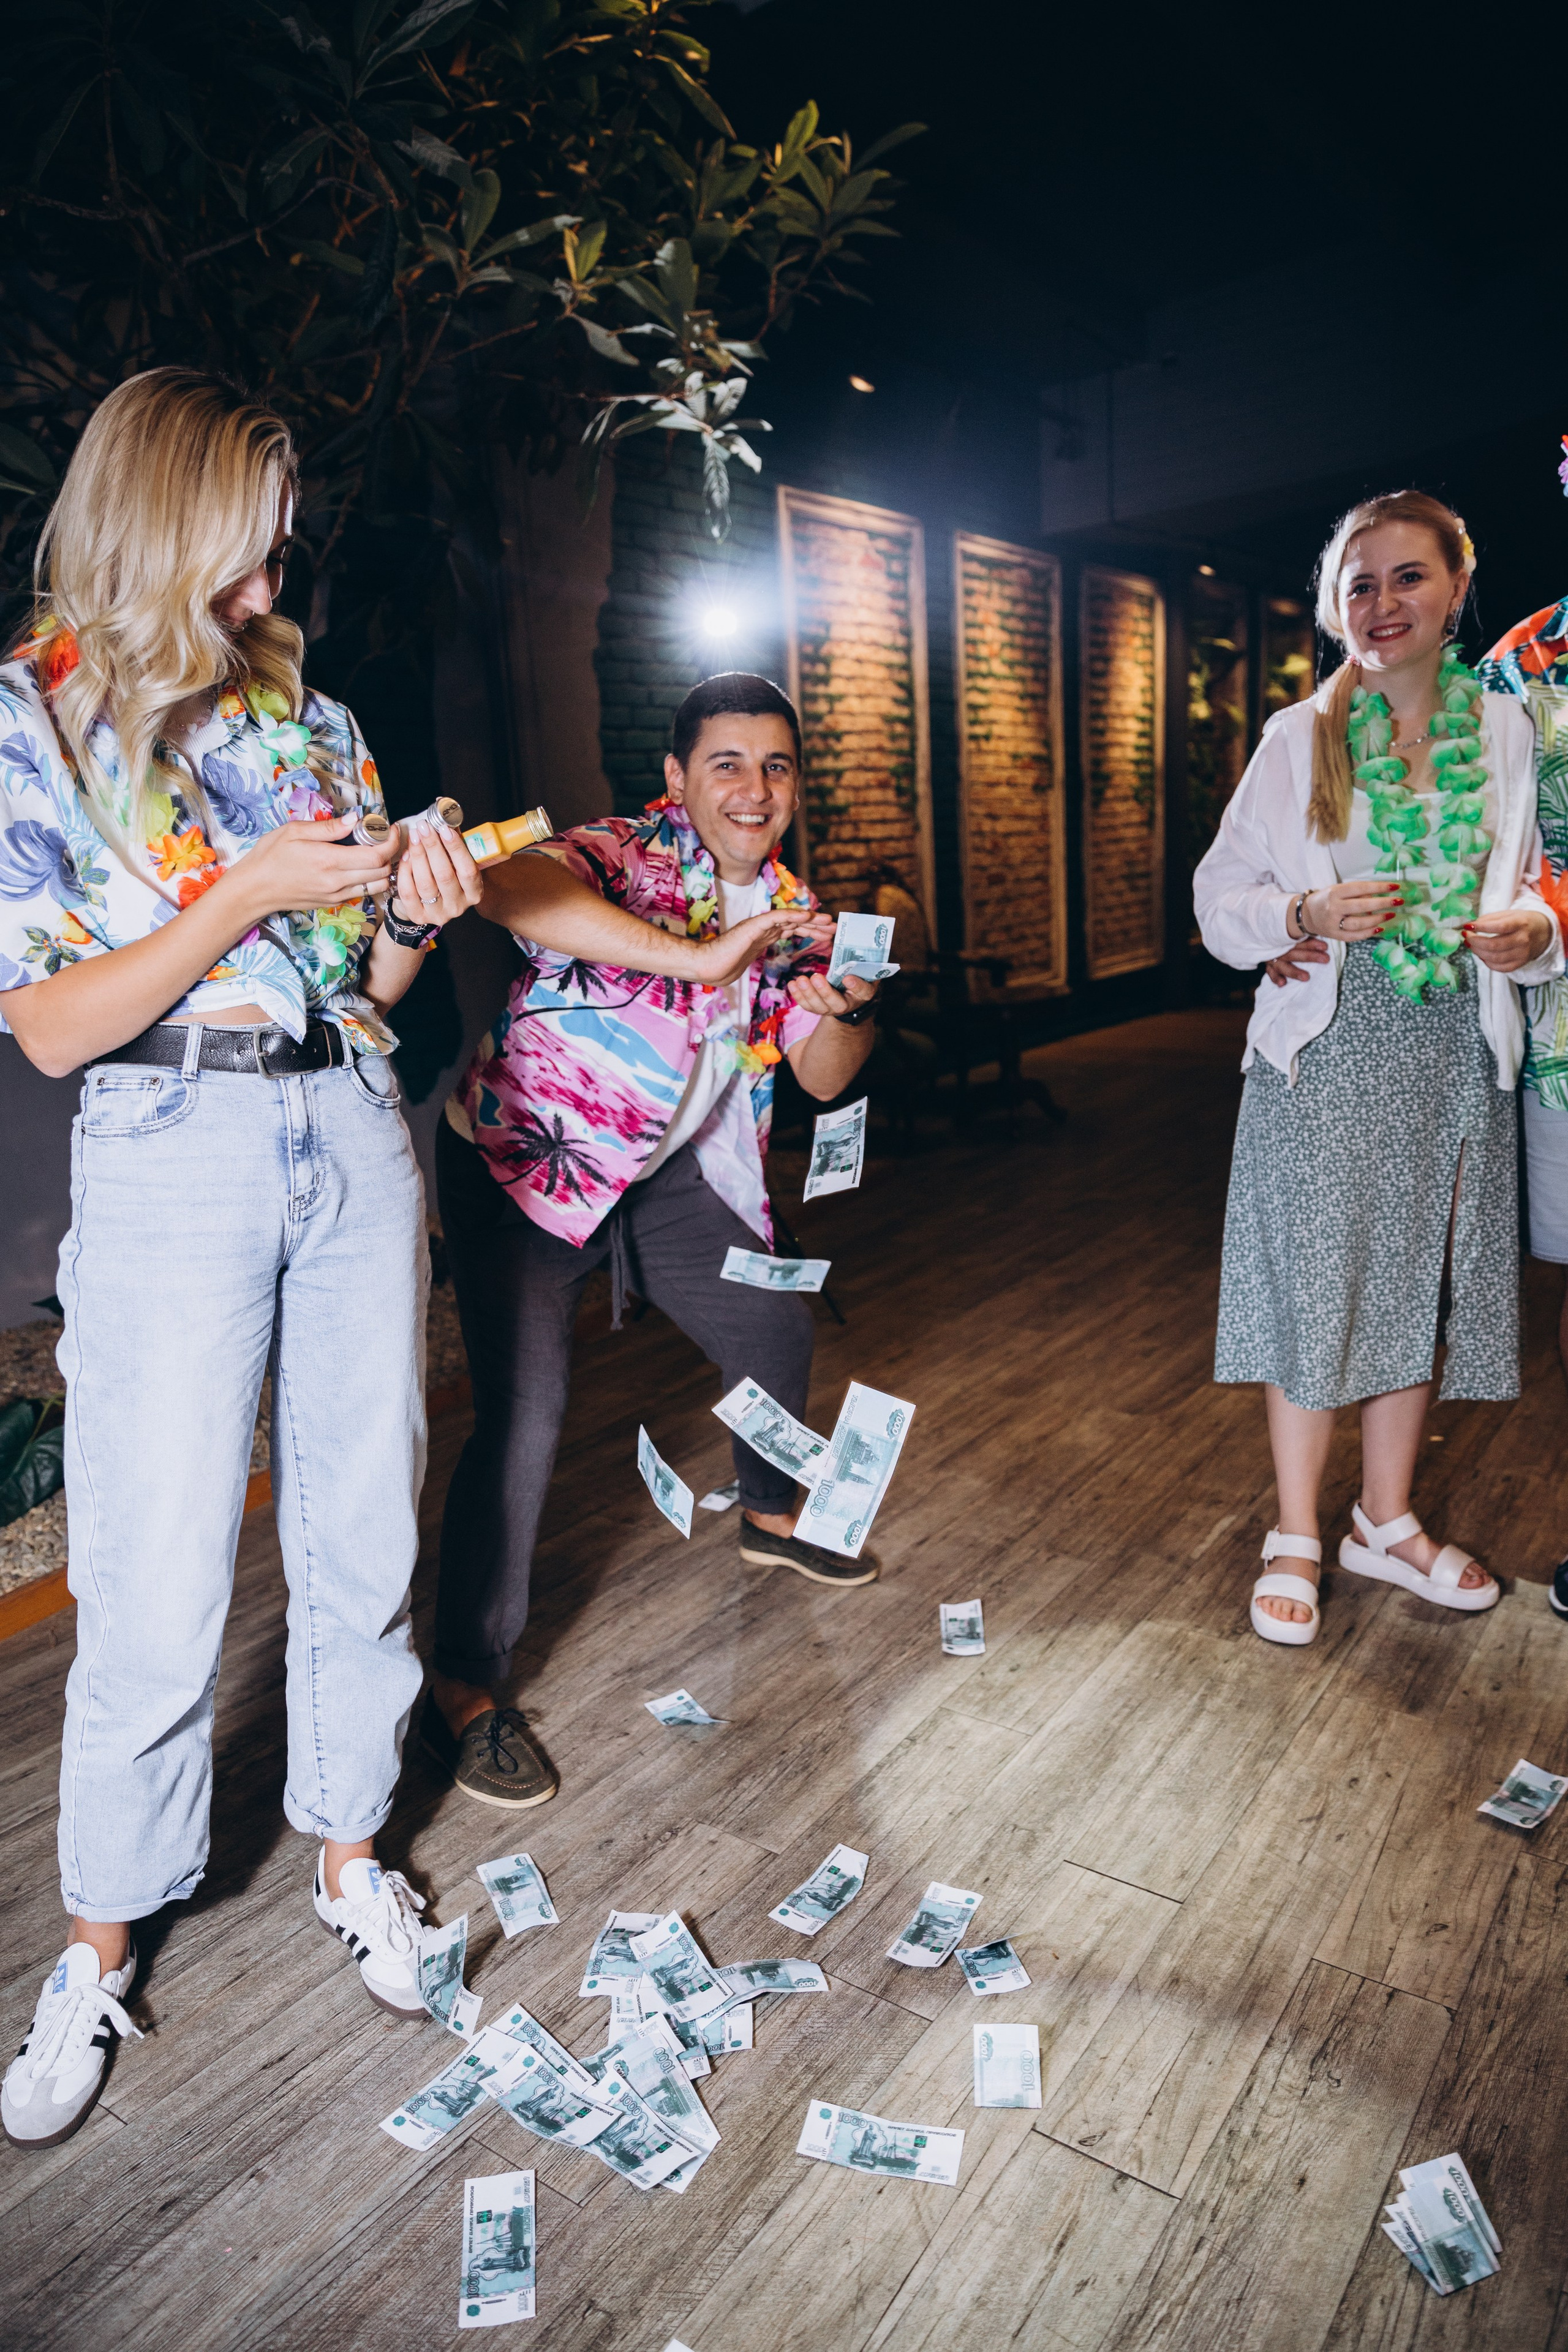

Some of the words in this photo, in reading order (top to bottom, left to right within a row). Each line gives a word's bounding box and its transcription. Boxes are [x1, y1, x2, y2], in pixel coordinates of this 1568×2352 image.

[443, 803, 458, 816] AMG
[760, 1398, 783, 1419] 1000
[845, 1395, 858, 1425] ТЫСЯЧА
[892, 1412, 903, 1436] 1000
[810, 1479, 835, 1518] 1000
[850, 1525, 862, 1546] 1000
[499, 1898, 516, 1920] 1000
[542, 1904, 551, 1917] 1000
[787, 1893, 805, 1907] 1000
[956, 1908, 971, 1924] 1000
[677, 1934, 694, 1956] 1000
[591, 1954, 605, 1975] 1000
[717, 1967, 736, 1978] 100
[965, 1960, 981, 1978] 1000
[429, 2000, 448, 2022] 1000
[521, 2021, 540, 2041] 1000
[440, 2069, 453, 2081] БИЛЕТ
[453, 2056, 467, 2069] БАНКА
[466, 2033, 487, 2055] ПРИКОЛОВ
[706, 2043, 725, 2051] 100
[550, 2046, 561, 2057] БИЛЕТ
[559, 2055, 571, 2067] БАНКА
[570, 2065, 588, 2082] ПРИКОЛОВ
[653, 2047, 676, 2073] 1000
[1022, 2050, 1035, 2091] 1000
[535, 2064, 557, 2086] 1000
[405, 2092, 431, 2114] 1000
[570, 2092, 582, 2101] БИЛЕТ
[581, 2098, 594, 2107] БАНКА
[593, 2105, 614, 2116] ПРИКОЛОВ
[620, 2092, 643, 2116] 1000
[839, 2112, 867, 2128] 1000
[654, 2123, 665, 2135] БИЛЕТ
[663, 2132, 676, 2142] БАНКА
[674, 2139, 693, 2153] ПРИКОЛОВ
[1451, 2171, 1469, 2196] 1000
[1447, 2191, 1464, 2217] 1000
[467, 2271, 479, 2299] 1000
